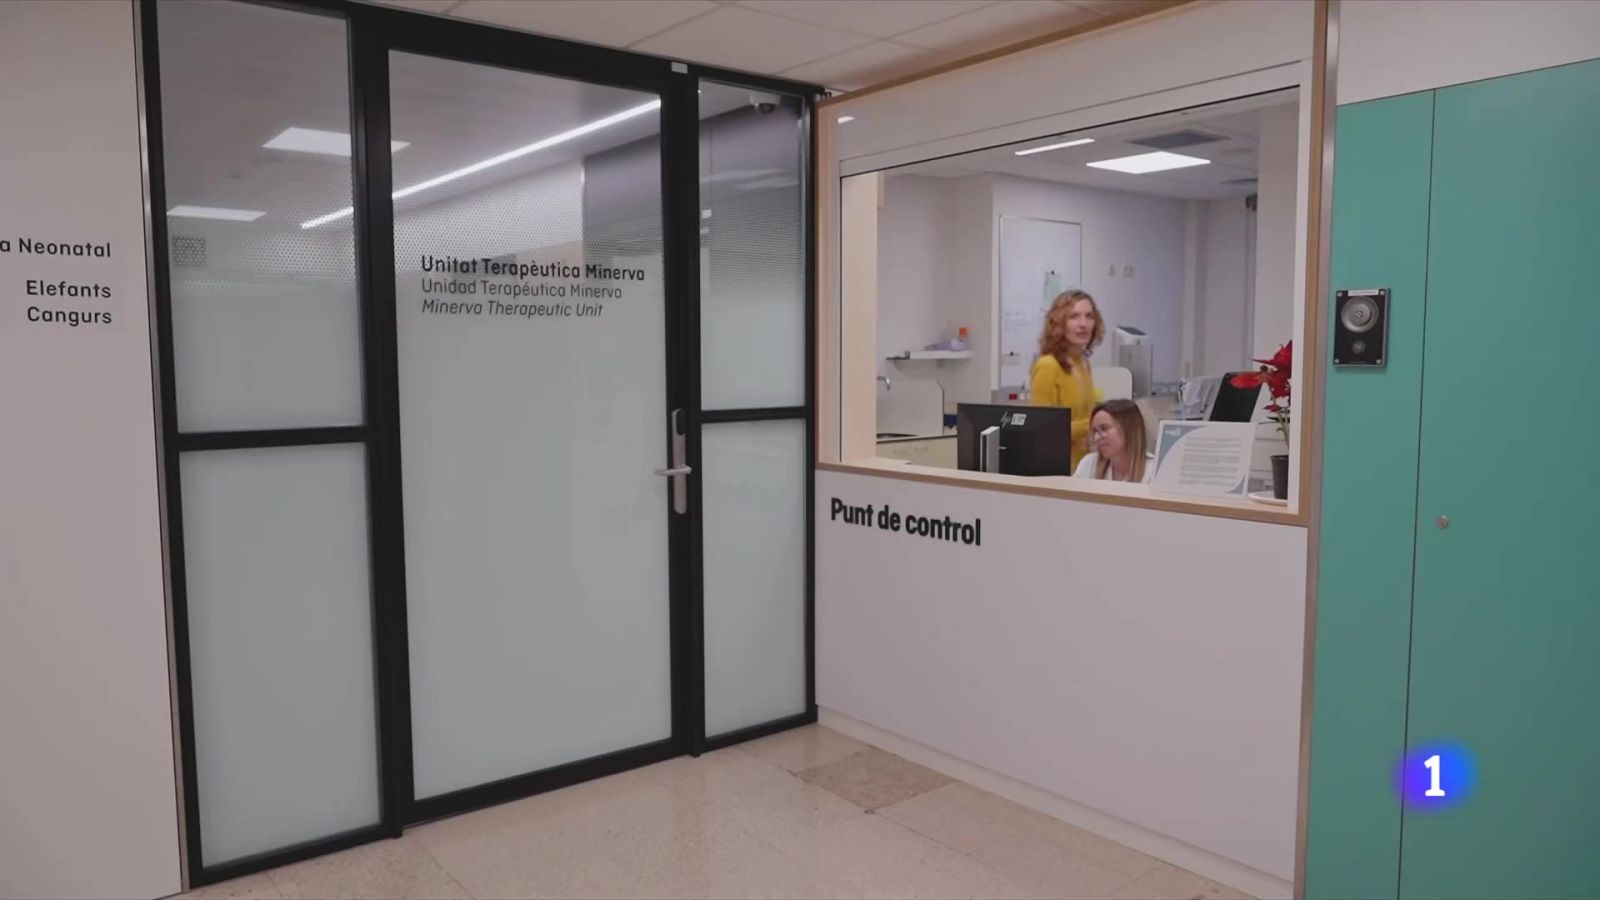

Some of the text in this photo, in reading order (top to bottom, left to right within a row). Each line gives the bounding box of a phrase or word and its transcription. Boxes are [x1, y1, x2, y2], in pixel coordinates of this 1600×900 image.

[19, 238, 111, 257] Neonatal
[421, 255, 645, 281] Unitat Terapèutica Minerva
[26, 280, 111, 298] Elefants
[421, 278, 622, 299] Unidad Terapéutica Minerva
[27, 306, 112, 327] Cangurs
[421, 299, 603, 319] Minerva Therapeutic Unit
[831, 497, 981, 546] Punt de control
